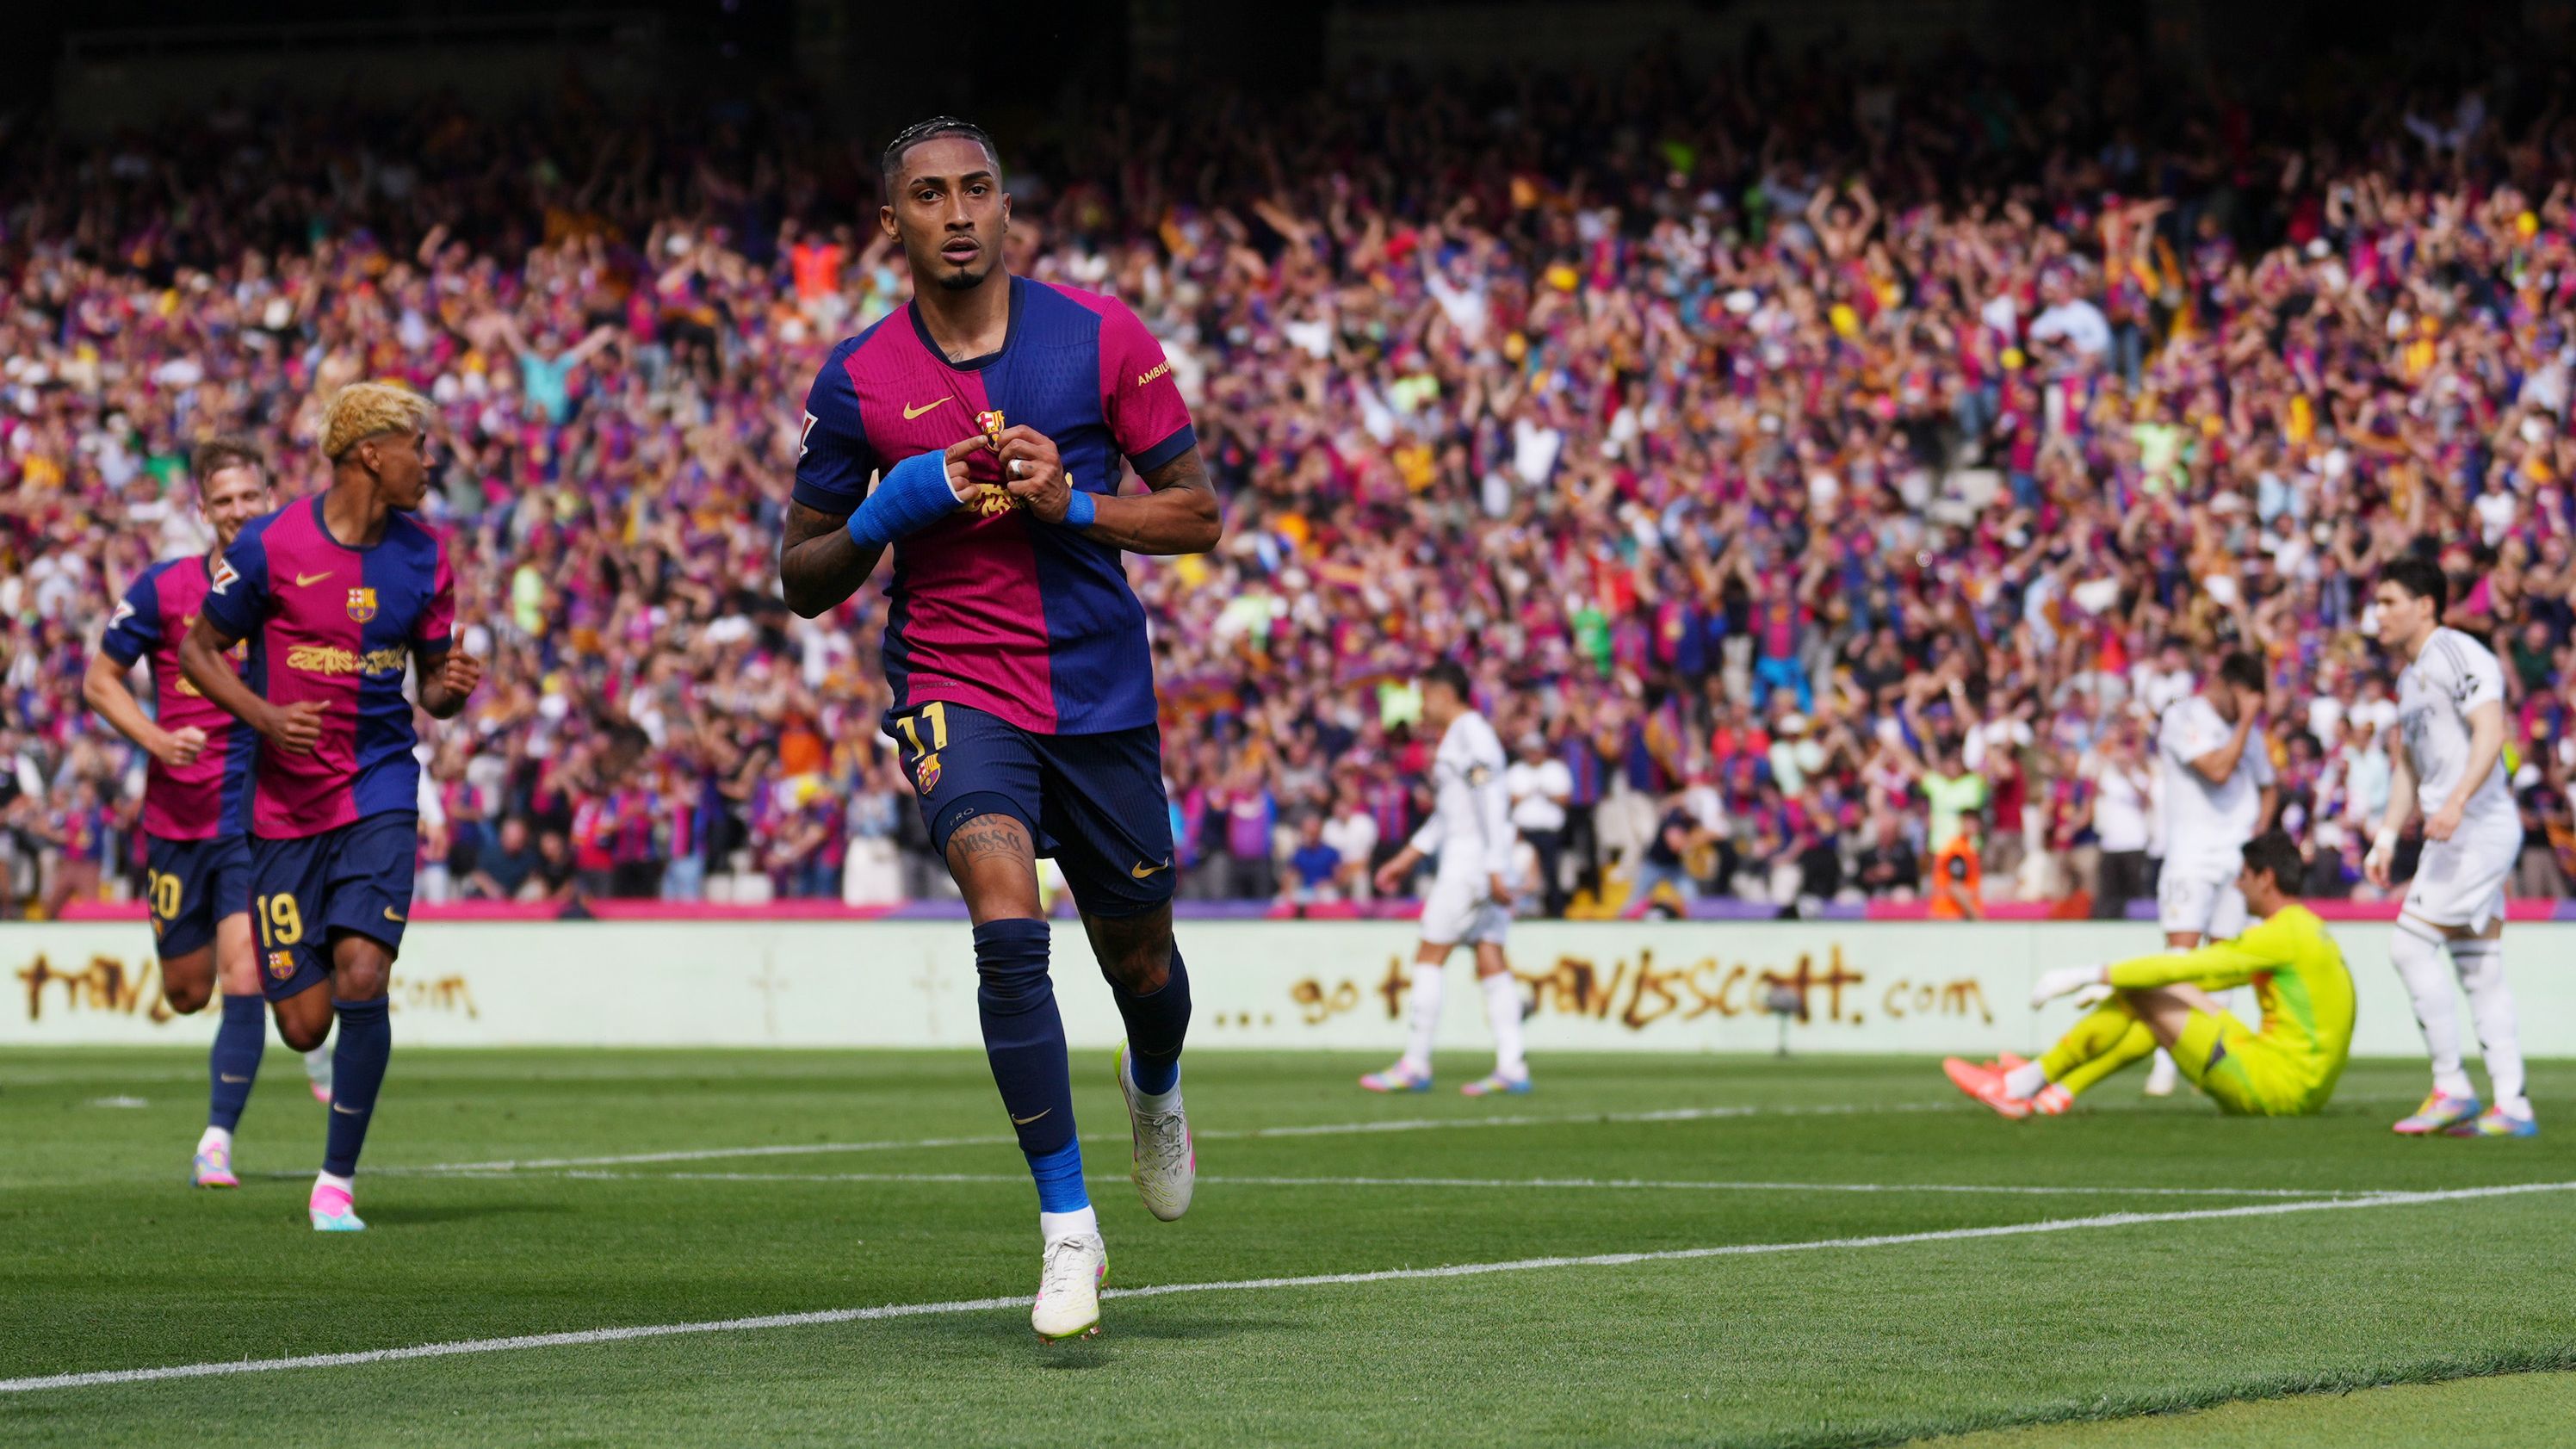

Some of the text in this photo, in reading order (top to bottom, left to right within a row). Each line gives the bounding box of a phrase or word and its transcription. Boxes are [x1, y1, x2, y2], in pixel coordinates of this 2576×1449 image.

[896, 701, 947, 763] 11
[147, 867, 183, 920] 20
[257, 891, 303, 948] 19
[1291, 978, 1359, 1026] go
